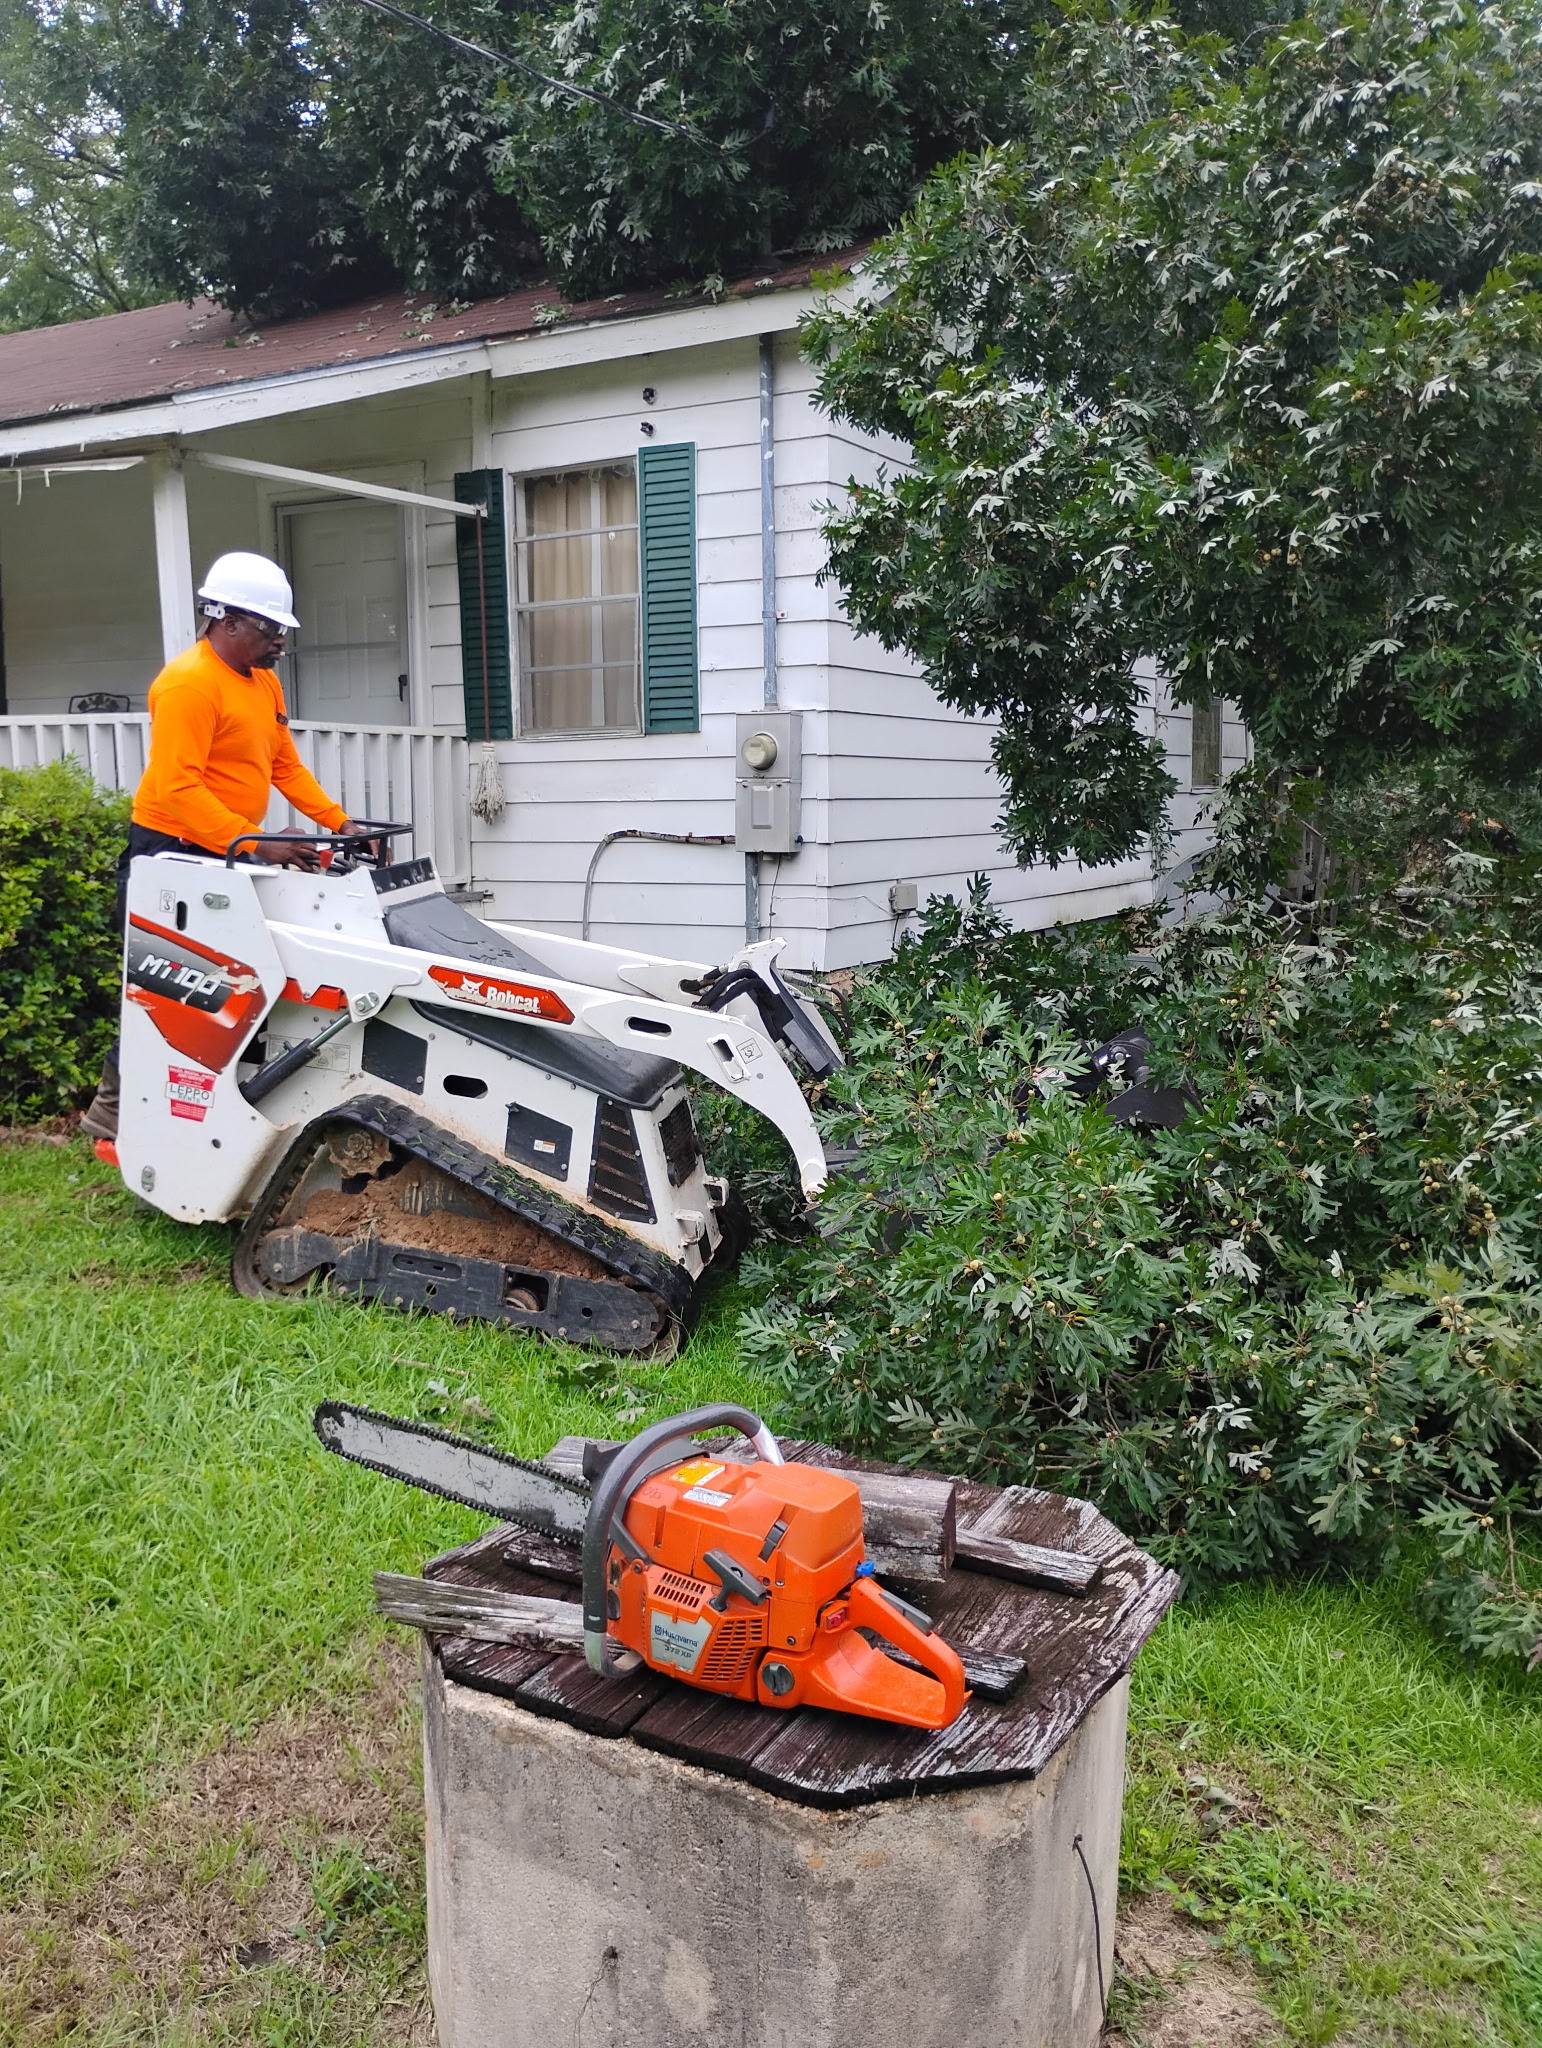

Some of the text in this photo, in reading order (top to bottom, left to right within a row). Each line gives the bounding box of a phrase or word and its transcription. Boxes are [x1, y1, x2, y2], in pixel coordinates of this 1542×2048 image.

[138, 953, 222, 996] MT100
[487, 986, 541, 1013] Bobcat
[170, 1083, 210, 1100] LEPPO
[662, 1628, 698, 1647] Husqvarna
[680, 1650, 692, 1658] XP
